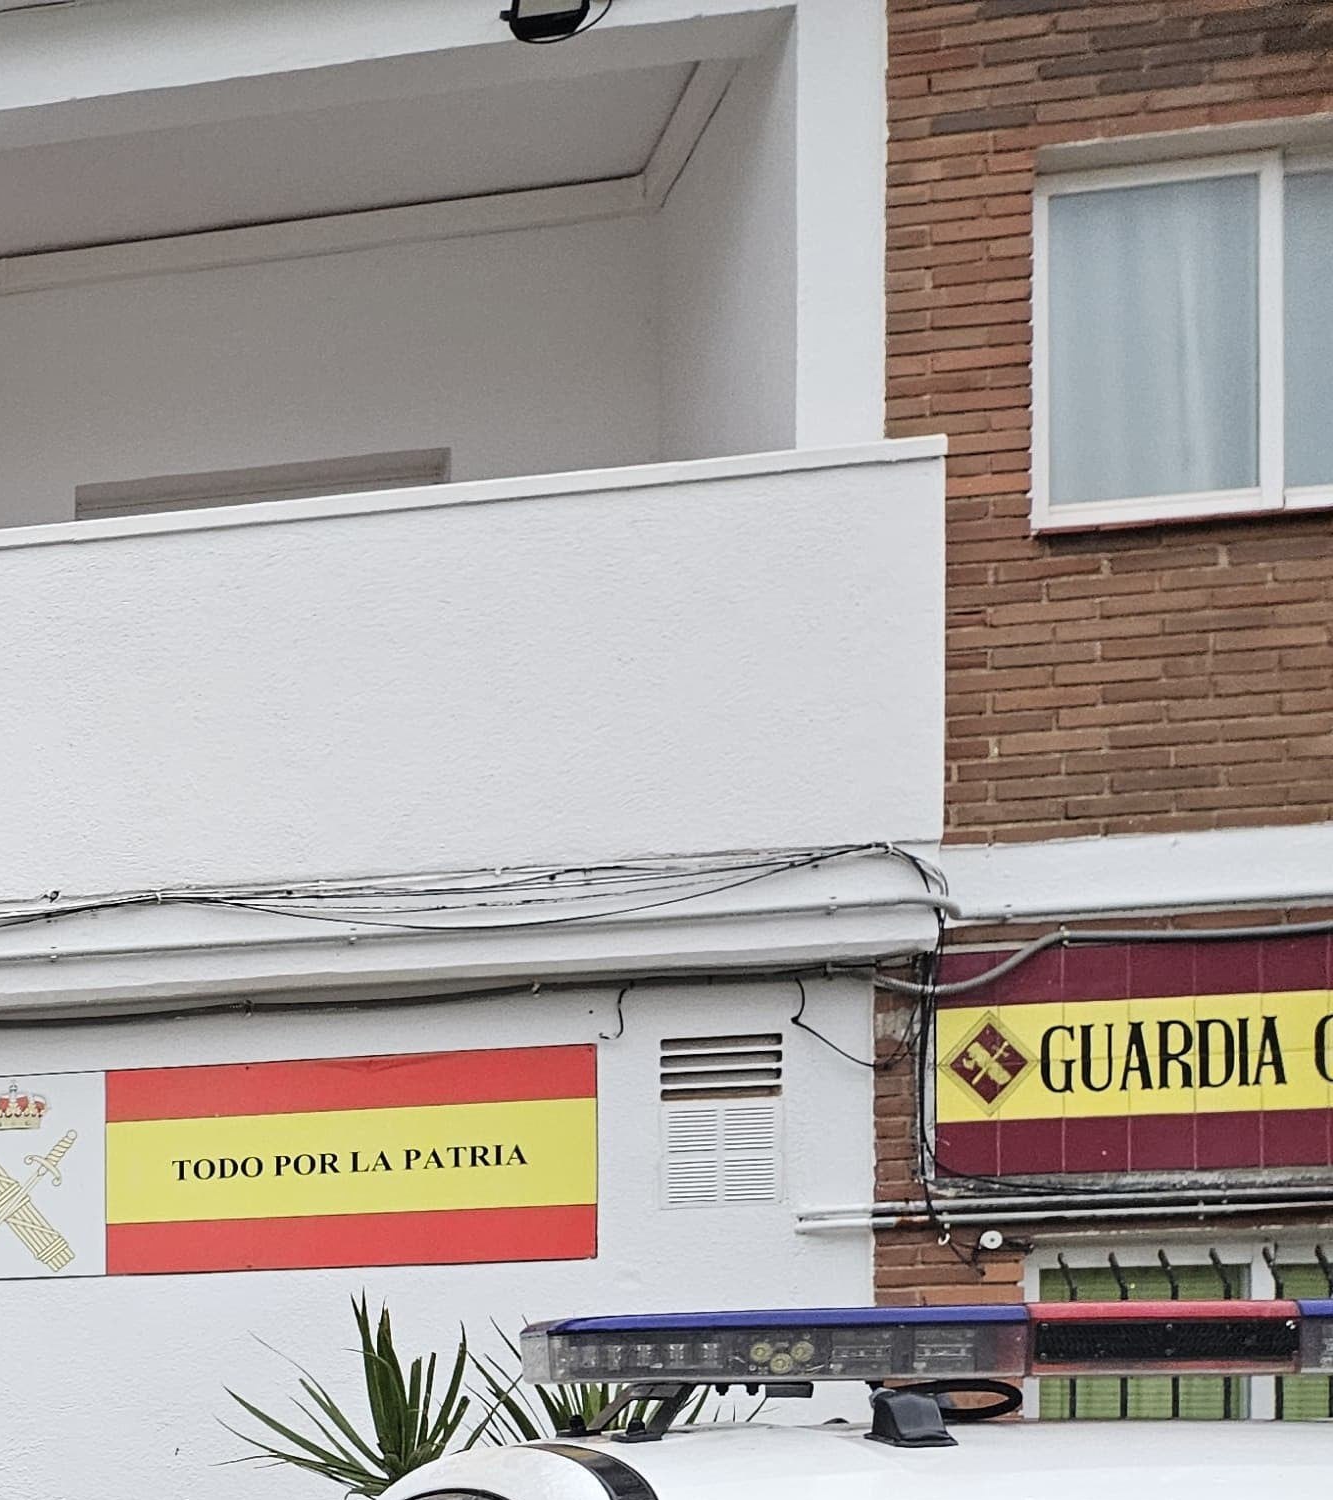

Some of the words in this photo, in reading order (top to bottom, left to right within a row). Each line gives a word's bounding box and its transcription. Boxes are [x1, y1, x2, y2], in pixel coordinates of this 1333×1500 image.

[1039, 1014, 1288, 1094] GUARDIA
[171, 1156, 264, 1181] TODO
[273, 1153, 340, 1177] POR
[349, 1150, 392, 1174] LA
[402, 1143, 529, 1171] PATRIA
